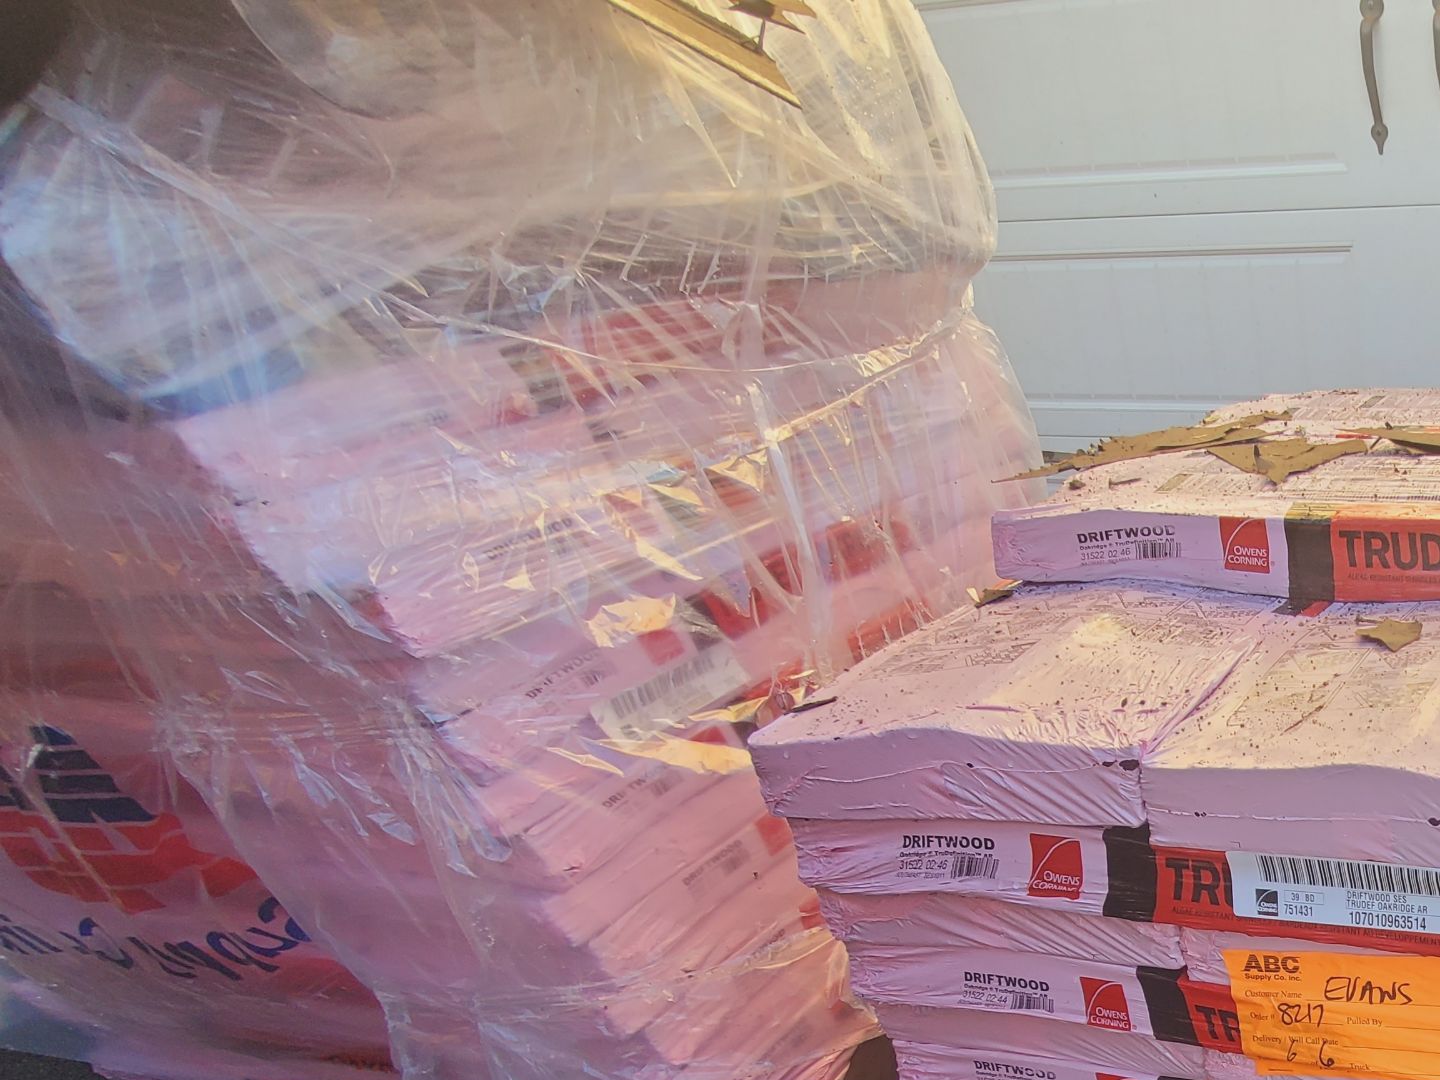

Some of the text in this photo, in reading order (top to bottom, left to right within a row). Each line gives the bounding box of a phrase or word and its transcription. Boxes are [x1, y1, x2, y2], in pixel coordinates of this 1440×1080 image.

[1077, 524, 1176, 544] DRIFTWOOD
[1081, 550, 1105, 561] 31522
[1233, 545, 1268, 557] OWENS
[1228, 554, 1268, 567] CORNING
[902, 834, 996, 850] DRIFTWOOD
[900, 859, 948, 870] 31522 02:46
[1044, 870, 1081, 886] OWENS
[1291, 892, 1300, 901] 39
[1347, 890, 1407, 903] DRIFTWOOD SES
[1284, 903, 1313, 917] 751431
[1346, 899, 1428, 914] TRUDEF OAKRIDGE AR
[1349, 911, 1427, 931] 107010963514
[1242, 953, 1302, 974] ABC
[964, 971, 1050, 992] DRIFTWOOD
[1244, 972, 1272, 982] Supply
[1244, 989, 1303, 999] Customer Name
[1324, 976, 1414, 1006] EVANS
[1095, 1006, 1128, 1020] OWENS
[1250, 1011, 1269, 1021] Order
[1090, 1015, 1129, 1029] CORNING
[1347, 1016, 1383, 1028] Pulled By
[1252, 1034, 1282, 1045] Delivery
[1306, 1036, 1321, 1045] Call
[974, 1060, 1057, 1080] DRIFTWOOD
[1349, 1062, 1370, 1071] Truck
